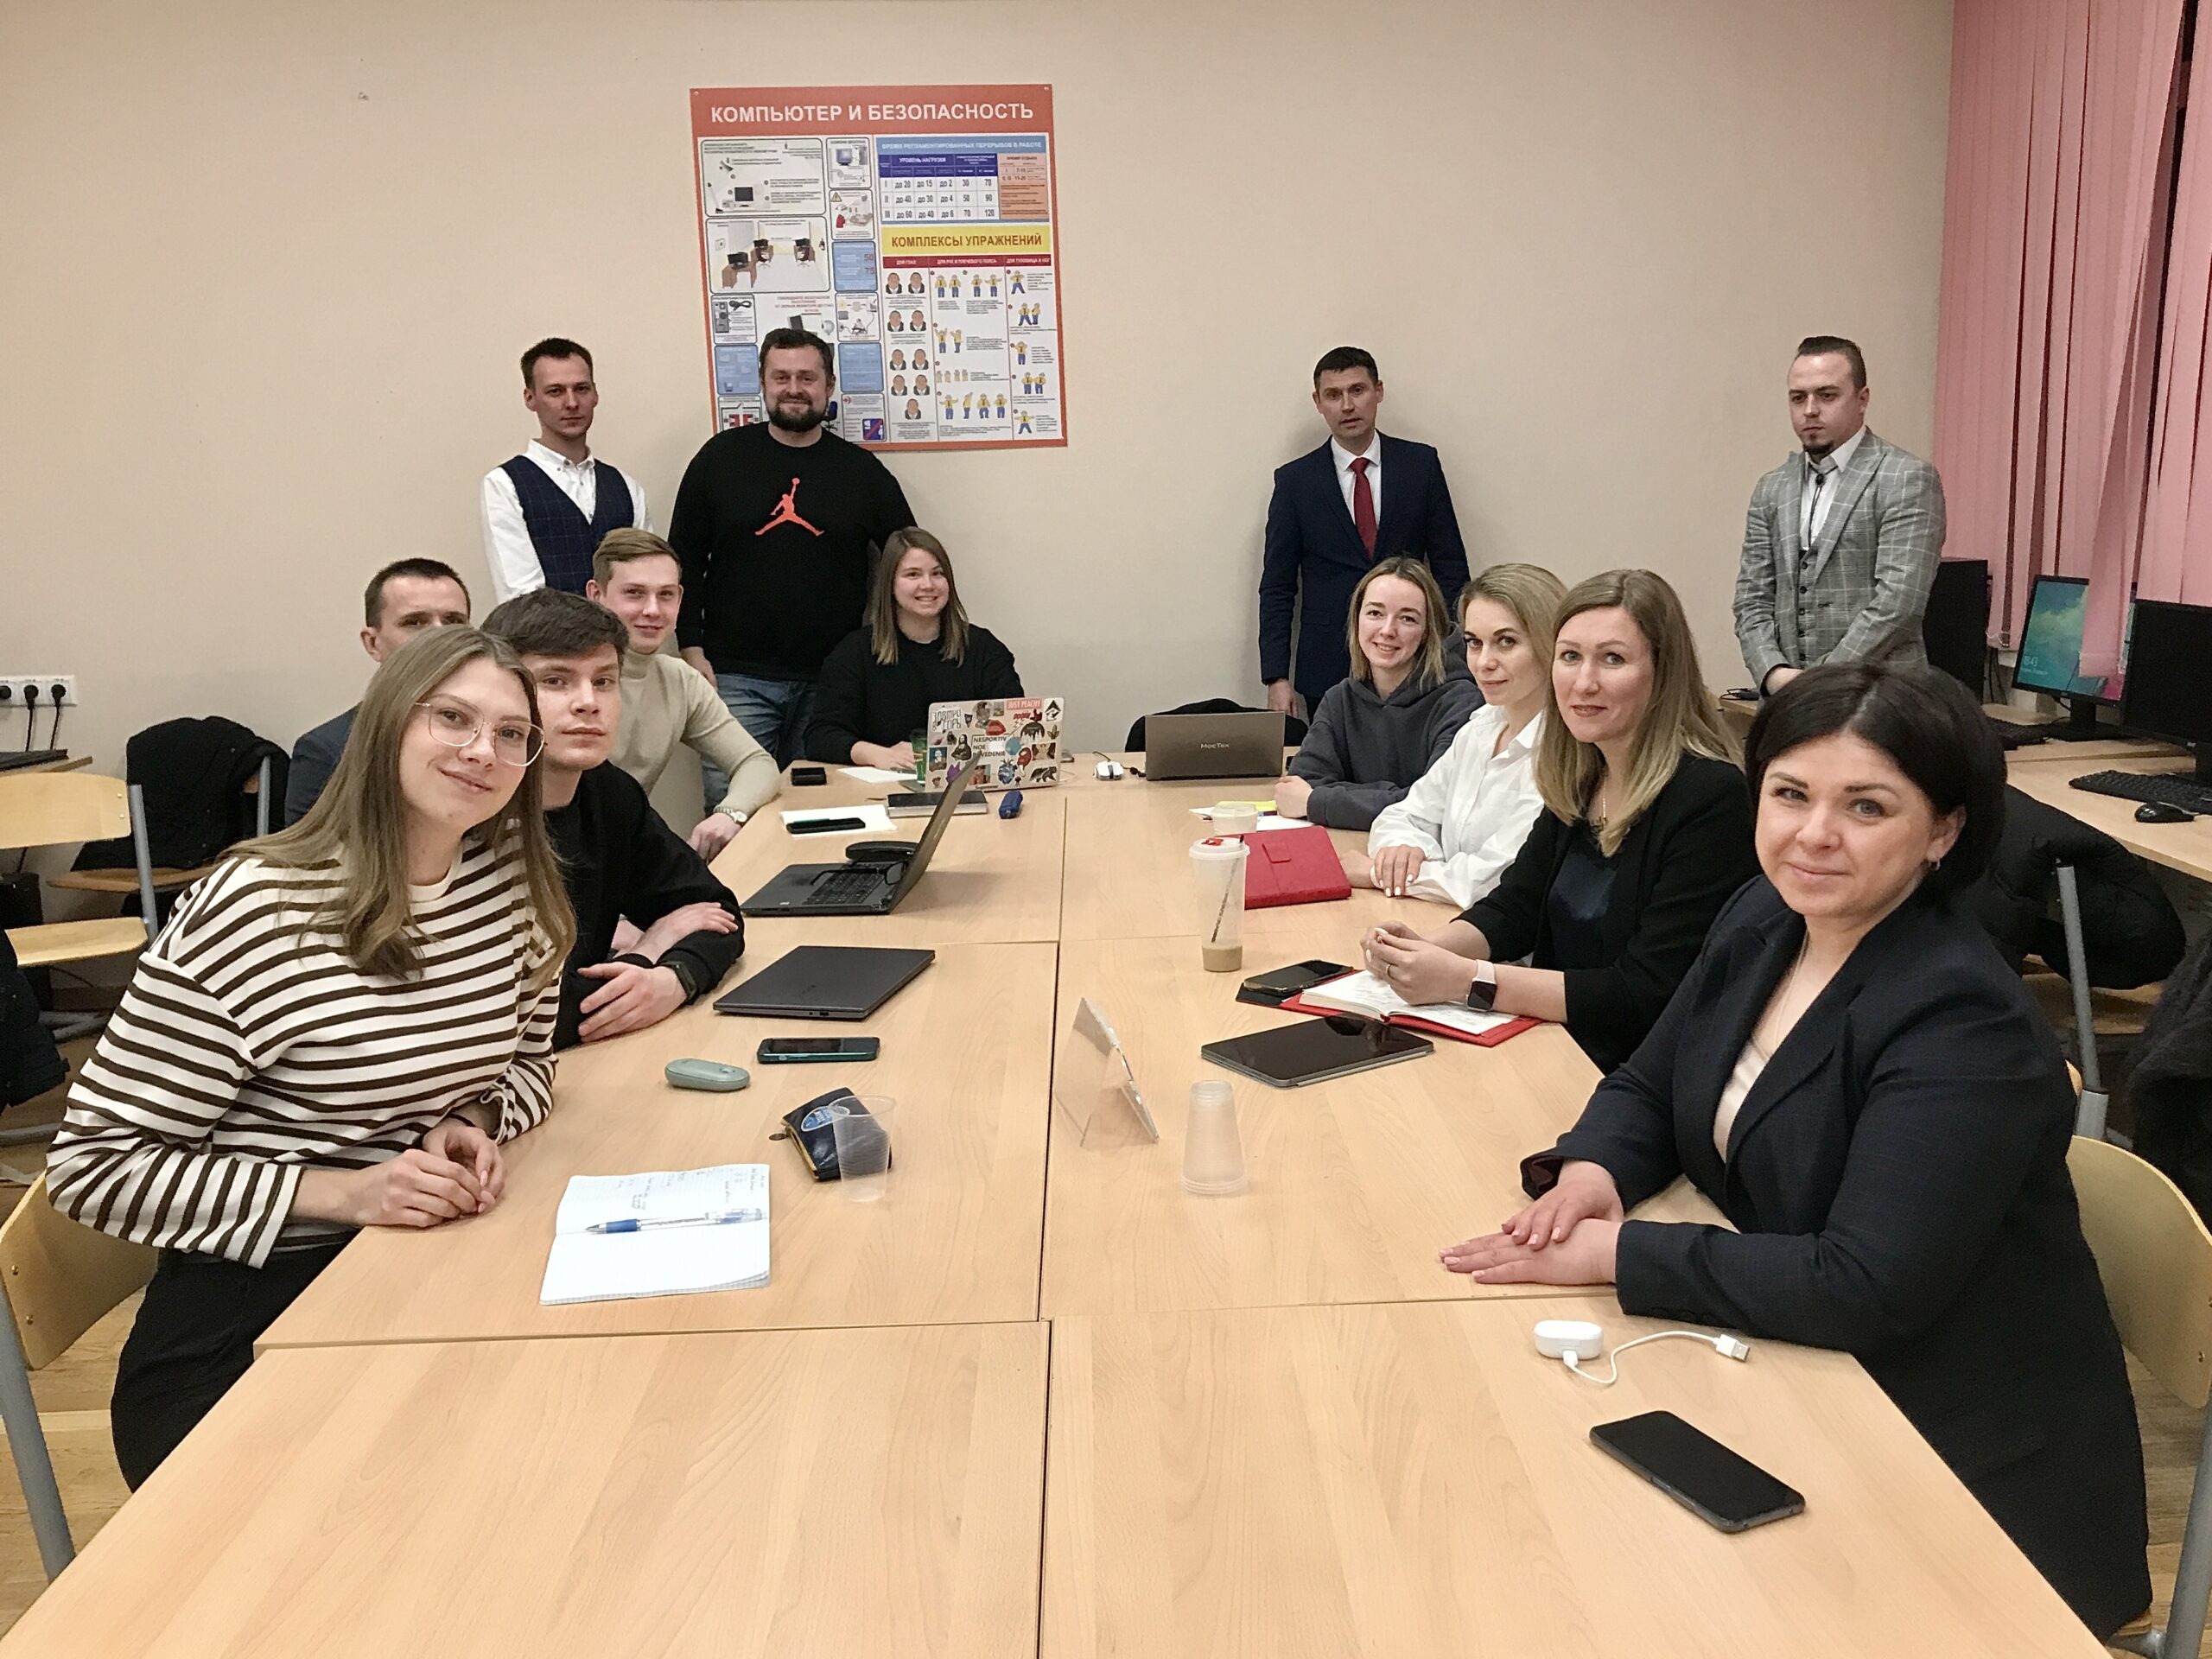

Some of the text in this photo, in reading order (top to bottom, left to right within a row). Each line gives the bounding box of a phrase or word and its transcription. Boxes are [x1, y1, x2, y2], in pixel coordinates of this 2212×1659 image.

[711, 103, 1034, 122] КОМПЬЮТЕР И БЕЗОПАСНОСТЬ
[892, 233, 1042, 247] КОМПЛЕКСЫ УПРАЖНЕНИЙ
[1021, 699, 1041, 708] PEACHY
